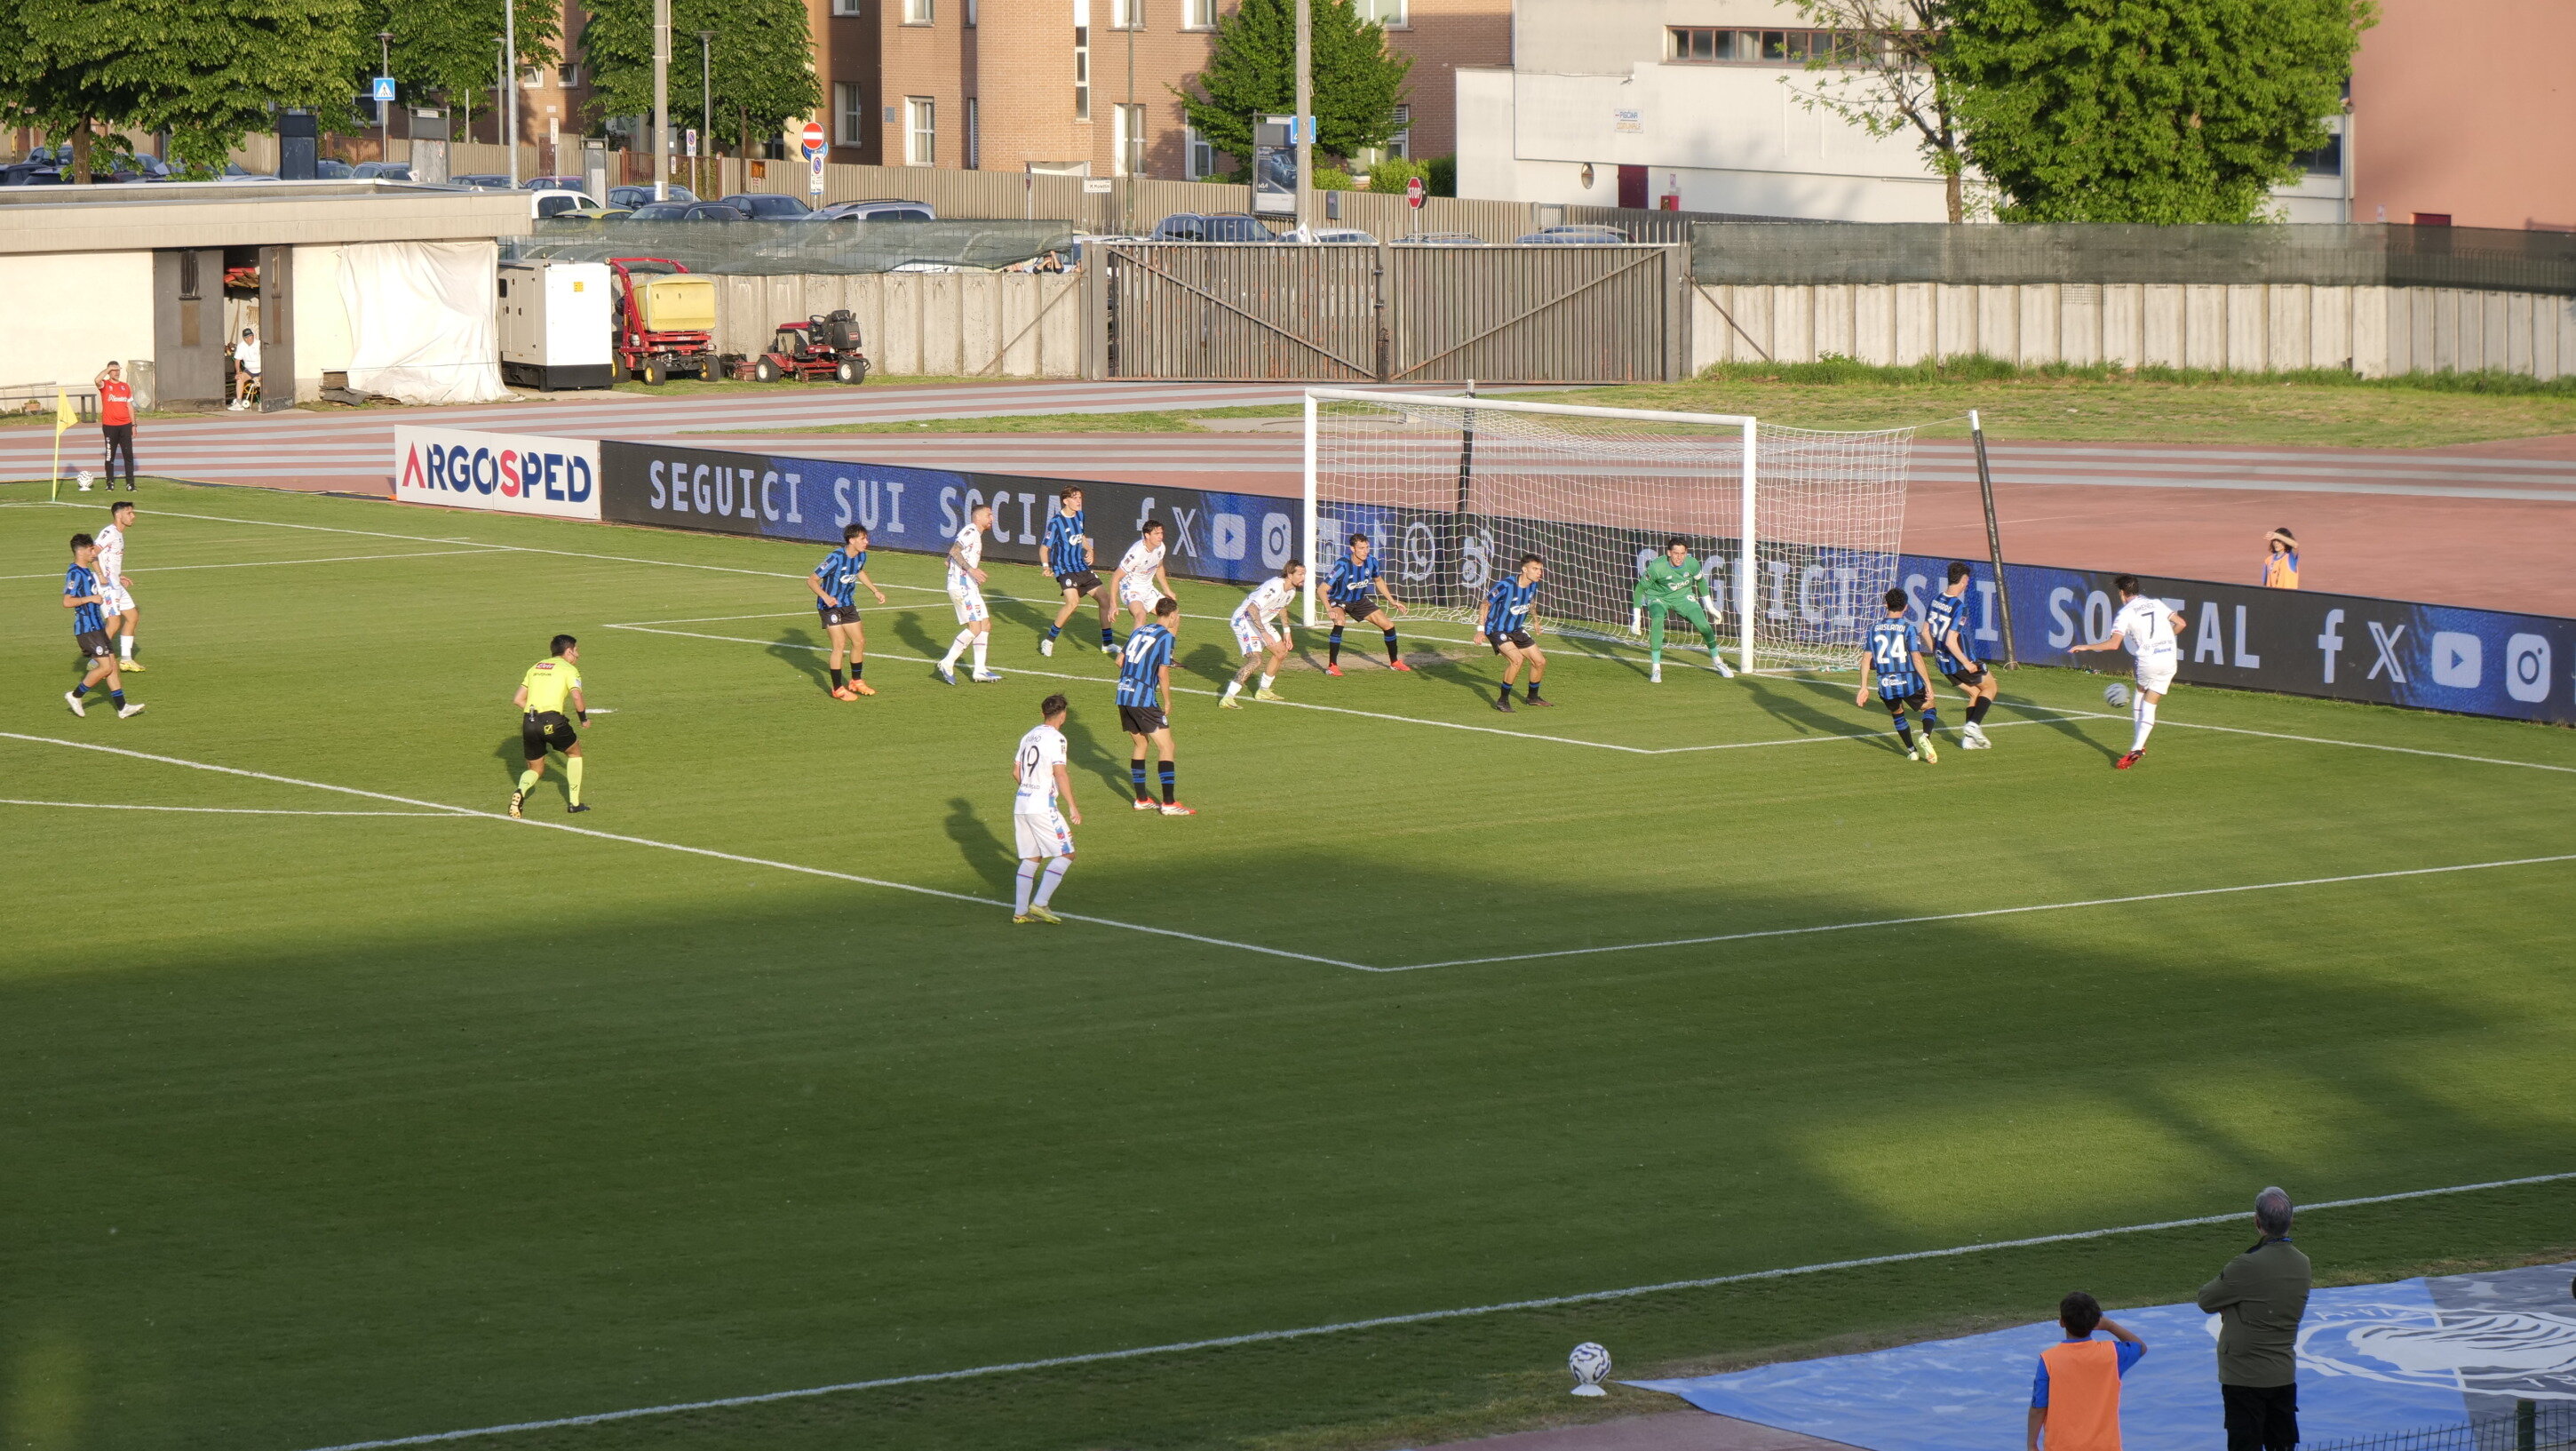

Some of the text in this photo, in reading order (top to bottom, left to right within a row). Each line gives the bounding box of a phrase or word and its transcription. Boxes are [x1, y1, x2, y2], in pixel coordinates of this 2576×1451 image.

[1408, 187, 1421, 199] STOP
[402, 441, 592, 503] ARGOSPED
[649, 459, 802, 524] SEGUICI
[834, 477, 904, 533] SUI
[939, 486, 1093, 548] SOCI
[1874, 624, 1906, 633] GHISLANDI
[1904, 573, 1999, 642] SI
[2048, 586, 2260, 669] SOAL
[1928, 610, 1952, 642] 37
[2141, 611, 2154, 639] 7
[1125, 634, 1157, 664] 47
[1873, 634, 1907, 664] 24
[1021, 745, 1040, 777] 19
